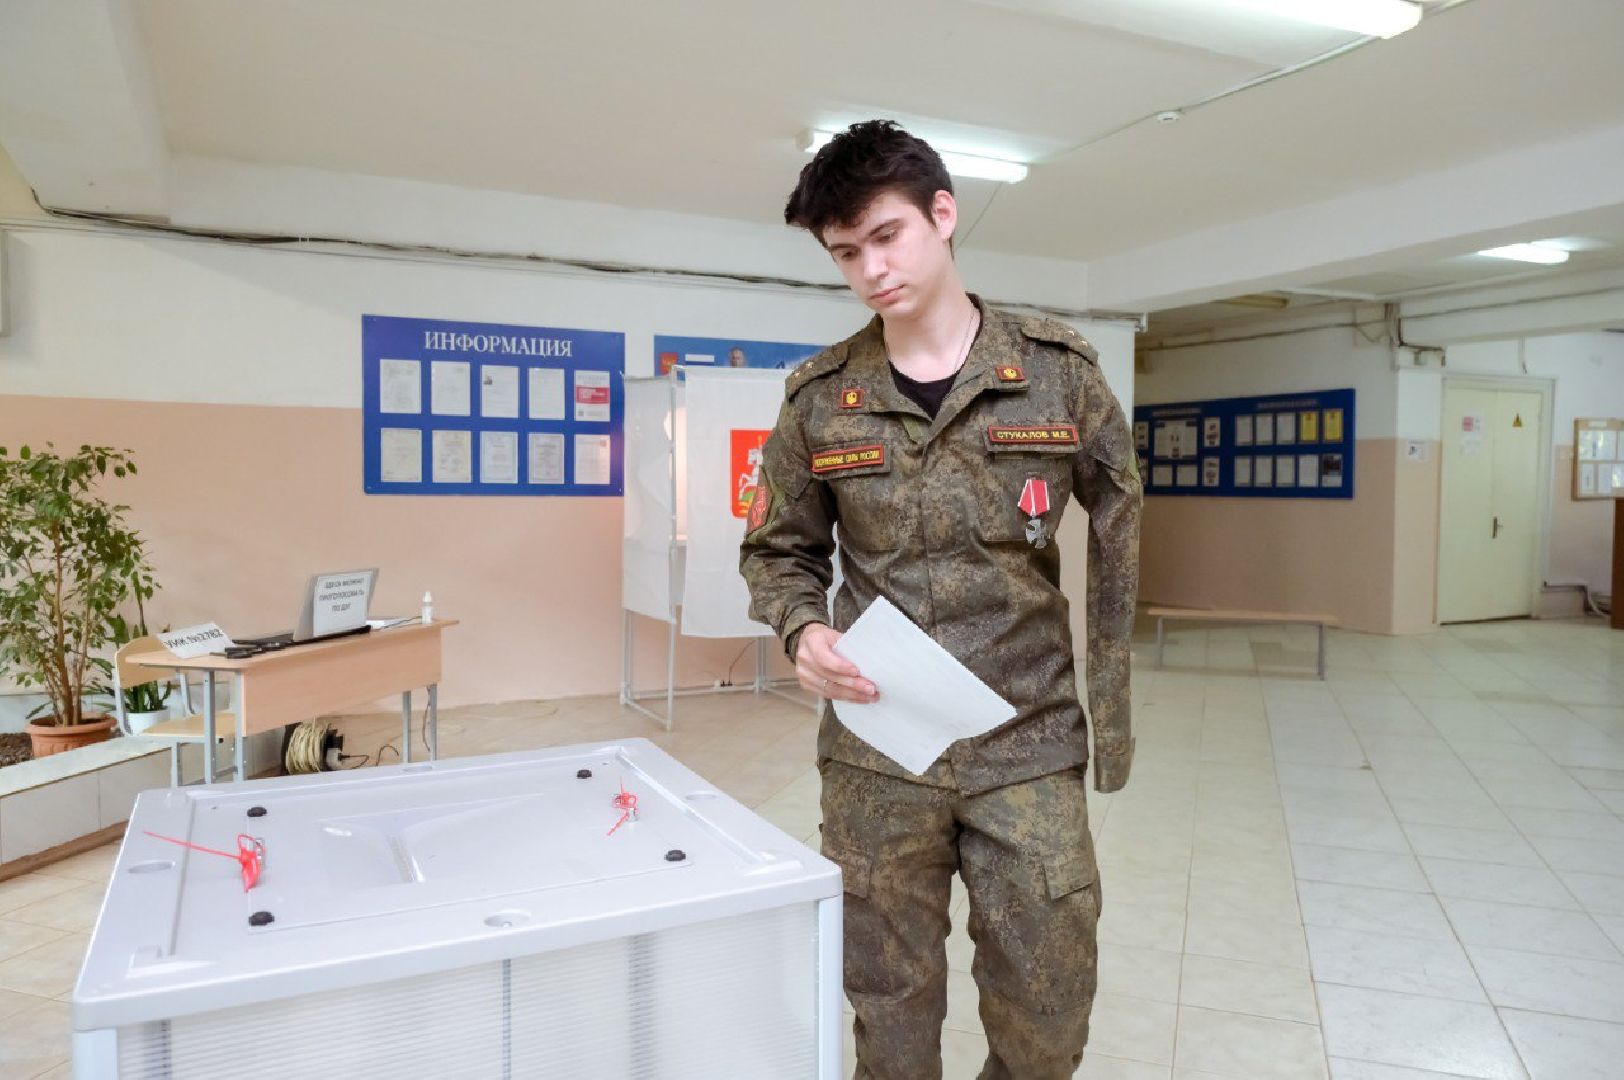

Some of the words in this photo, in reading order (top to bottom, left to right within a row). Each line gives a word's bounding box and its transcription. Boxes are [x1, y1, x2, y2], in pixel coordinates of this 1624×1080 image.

[424, 331, 573, 358] ИНФОРМАЦИЯ
[997, 430, 1049, 440] СТУКАЛОВ
[860, 450, 880, 461] РОССИИ
